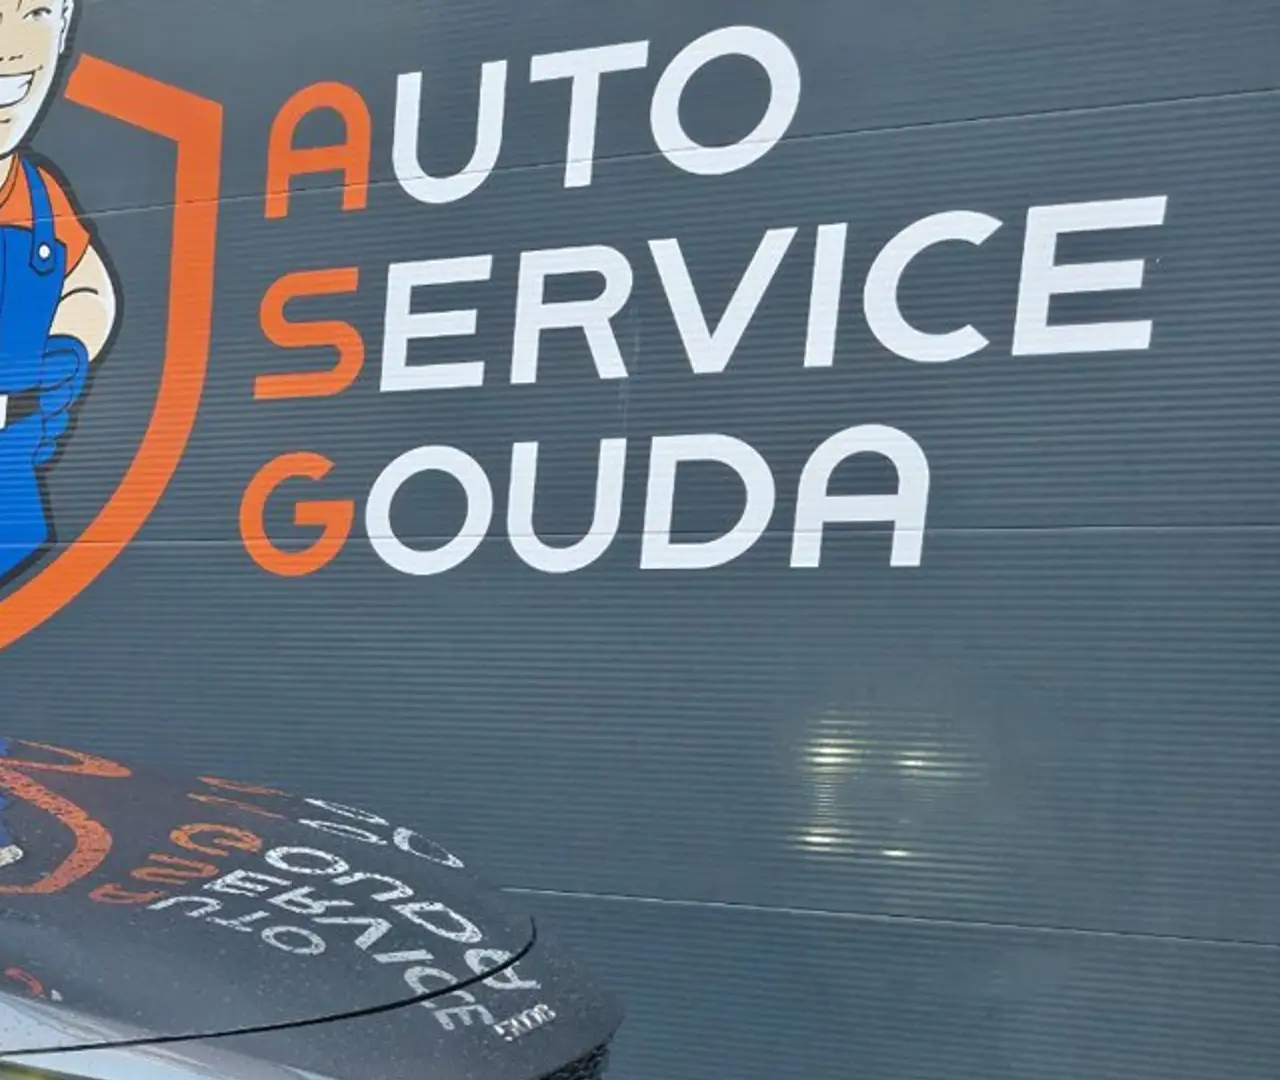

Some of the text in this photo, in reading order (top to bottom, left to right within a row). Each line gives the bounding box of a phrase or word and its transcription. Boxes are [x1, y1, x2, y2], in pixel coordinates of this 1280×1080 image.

[266, 25, 801, 220] AUTO
[253, 194, 1169, 399] SERVICE
[239, 423, 930, 577] GOUDA
